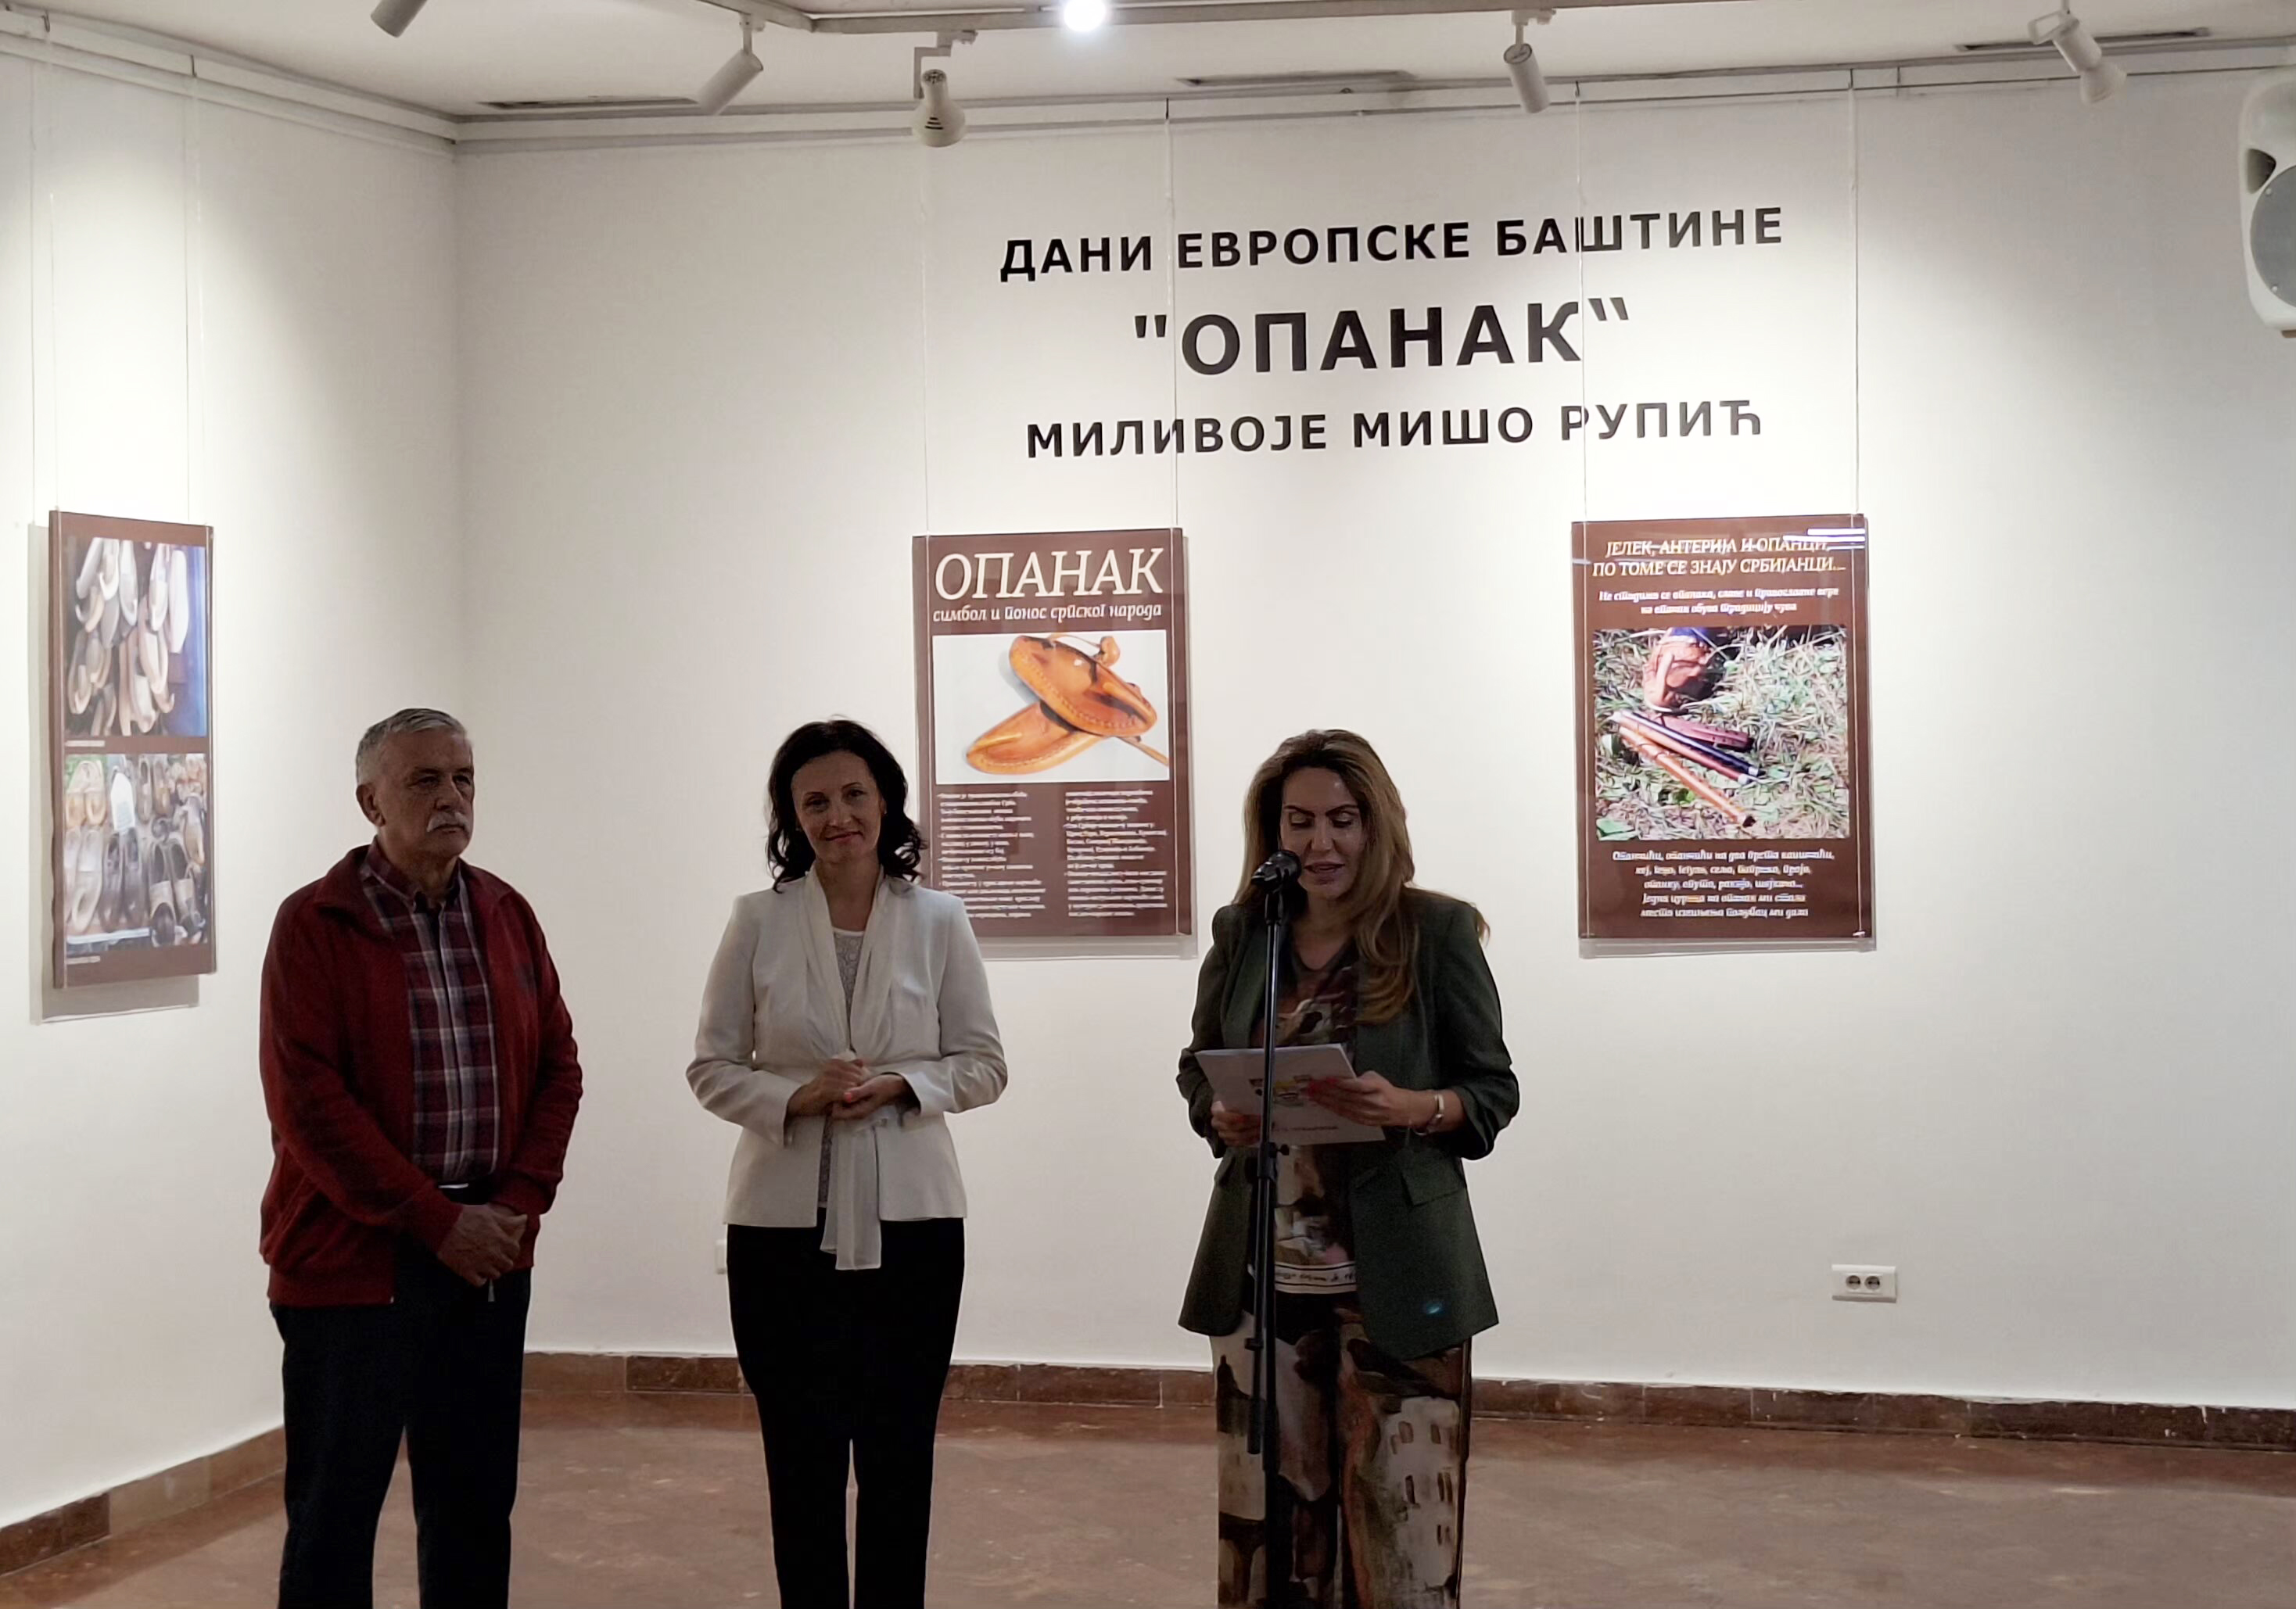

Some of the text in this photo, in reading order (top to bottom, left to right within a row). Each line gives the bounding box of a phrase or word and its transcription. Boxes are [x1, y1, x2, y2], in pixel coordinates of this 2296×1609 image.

[1001, 207, 1781, 282] ДАНИ ЕВРОПСКЕ БАШТИНЕ
[1028, 400, 1763, 458] МИЛИВОЈЕ МИШО РУПИЋ
[1605, 540, 1656, 558] ЈЕЛЕК,
[1659, 538, 1737, 555] АНТЕРИЈА
[1741, 537, 1753, 553] И
[936, 547, 1164, 600] ОПАНАК
[1592, 562, 1616, 577] ПО
[1619, 560, 1664, 576] ТОМЕ
[1666, 560, 1688, 575] СЕ
[1690, 557, 1738, 576] ЗНАЈУ
[933, 604, 1162, 624] симбол и понос српског народа
